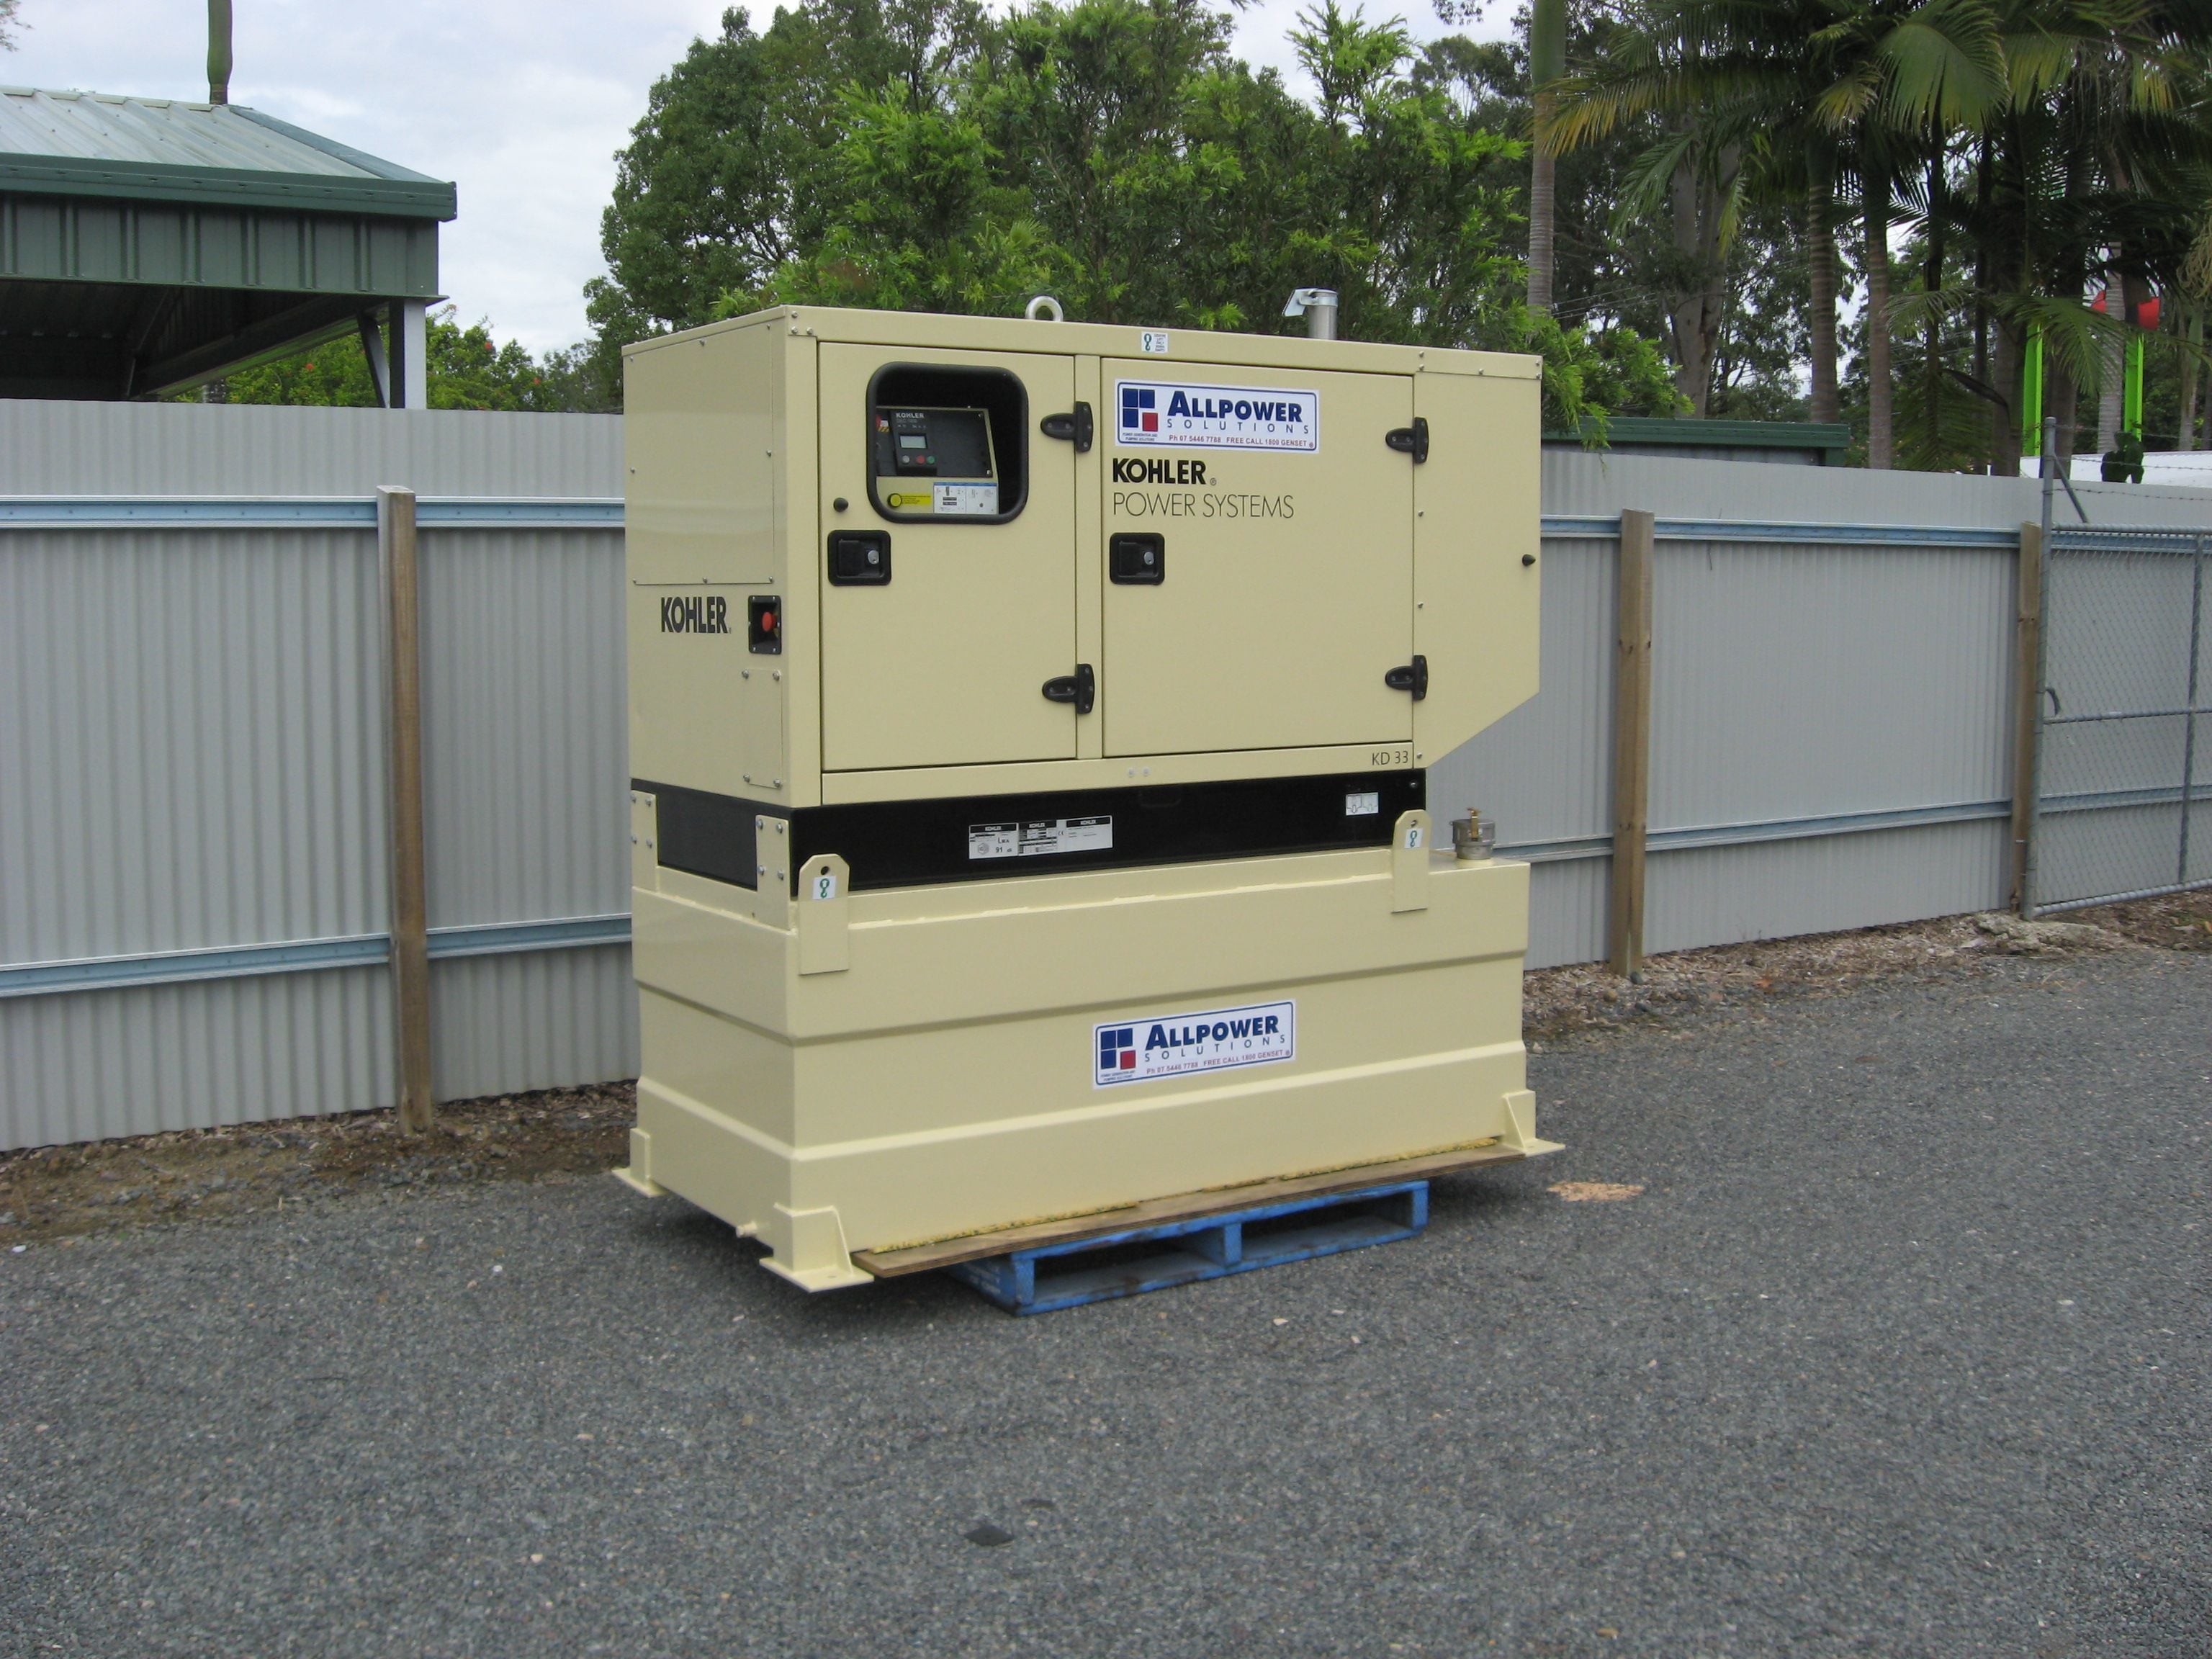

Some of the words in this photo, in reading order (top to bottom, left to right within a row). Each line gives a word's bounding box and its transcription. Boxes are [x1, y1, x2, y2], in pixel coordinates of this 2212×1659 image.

[1167, 390, 1303, 423] ALLPOWER
[1166, 418, 1309, 434] SOLUTIONS
[1112, 458, 1207, 485] KOHLER
[1113, 492, 1196, 517] POWER
[1202, 493, 1295, 518] SYSTEMS
[660, 596, 729, 634] KOHLER
[1372, 752, 1390, 765] KD
[1395, 750, 1408, 764] 33
[1145, 1015, 1280, 1051] ALLPOWER
[1144, 1034, 1285, 1063] SOLUTIONS
[1257, 1049, 1284, 1059] GENSET
